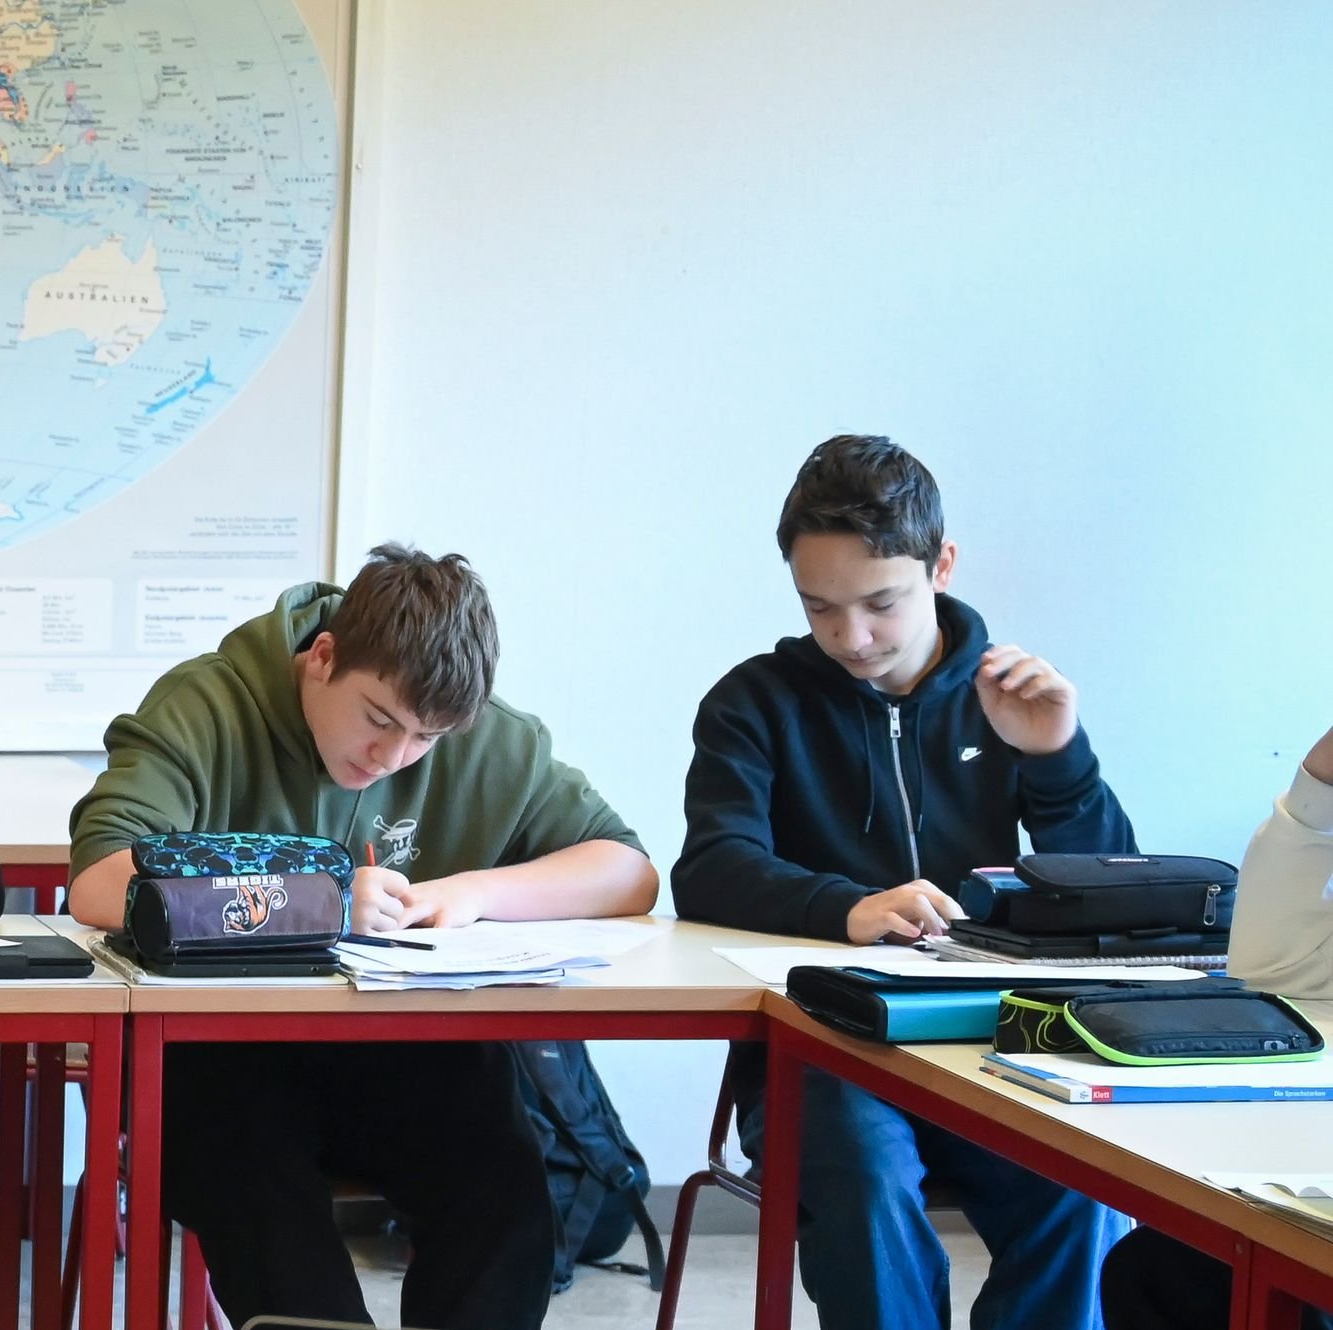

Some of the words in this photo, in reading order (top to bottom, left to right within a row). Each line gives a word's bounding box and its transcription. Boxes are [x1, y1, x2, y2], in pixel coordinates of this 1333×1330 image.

[44, 290, 149, 304] AUSTRALIEN
[1093, 1090, 1110, 1100] Klett
[1284, 1090, 1326, 1098] Sprachstarken
